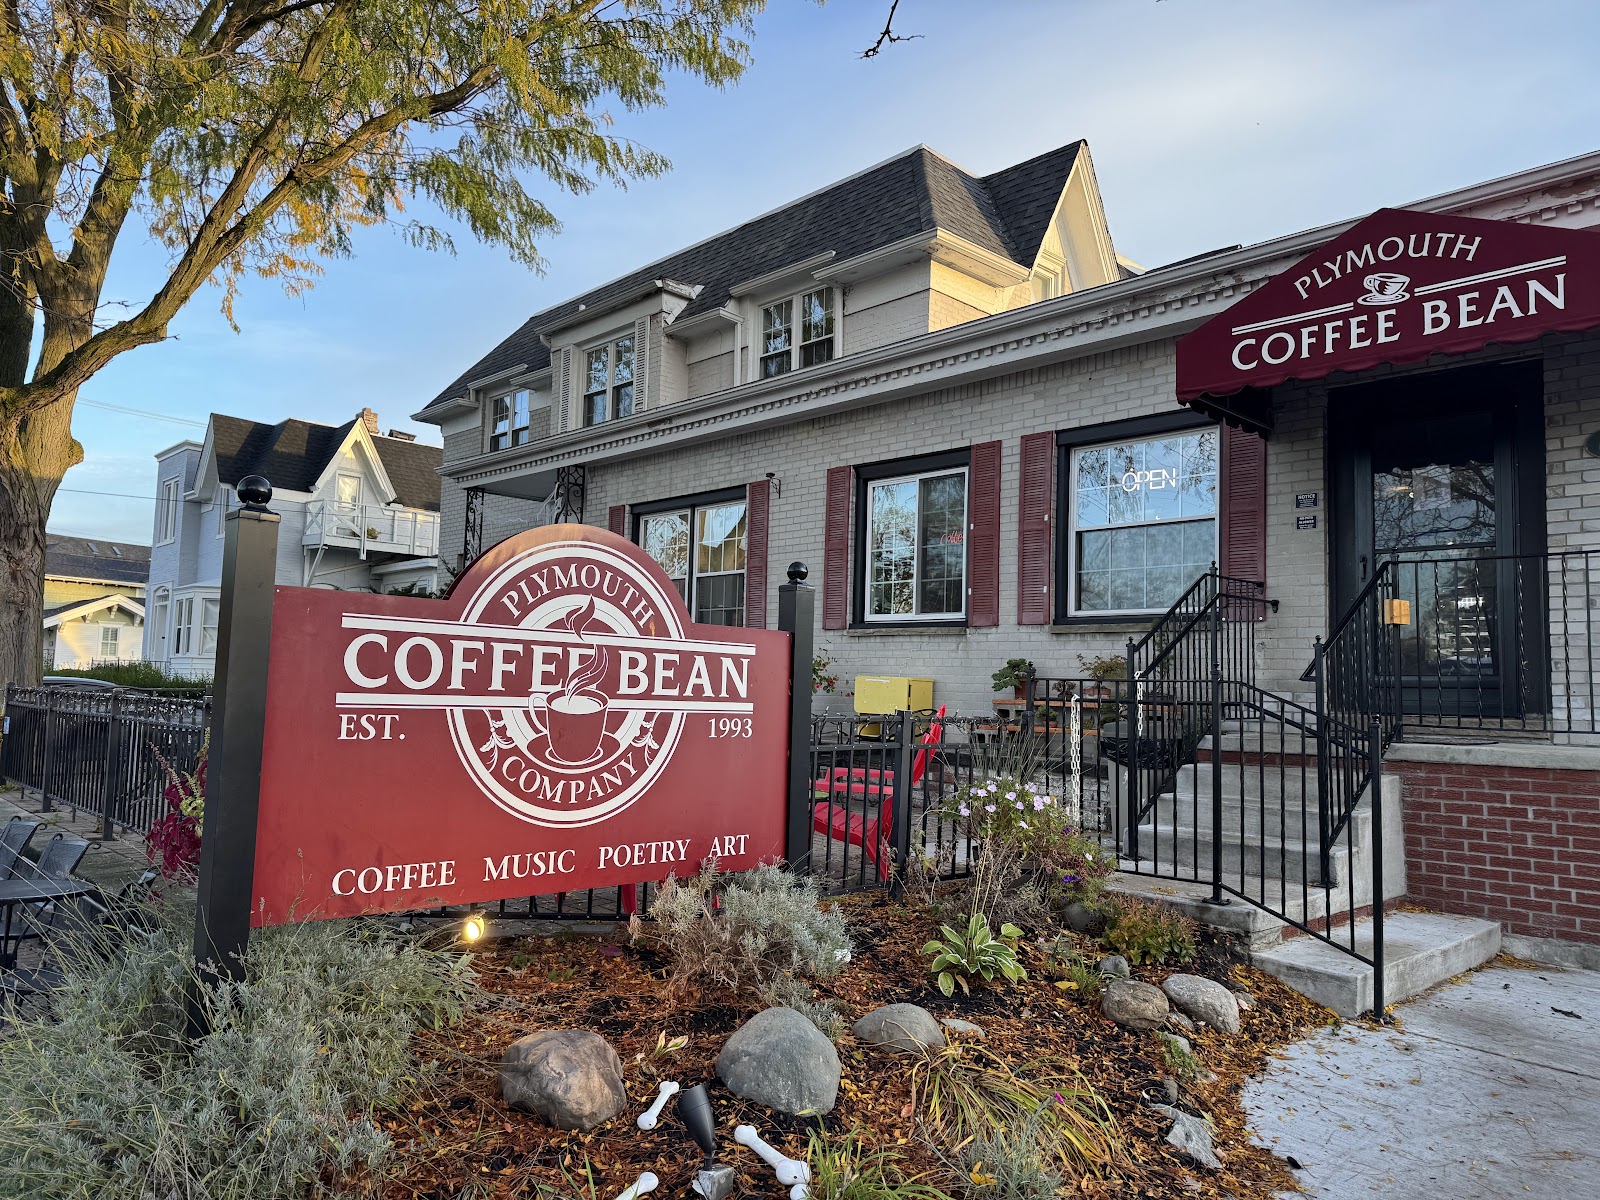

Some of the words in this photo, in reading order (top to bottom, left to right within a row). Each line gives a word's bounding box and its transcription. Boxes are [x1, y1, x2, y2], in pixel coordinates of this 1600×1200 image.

[1293, 232, 1482, 300] PLYMOUTH
[1231, 308, 1401, 371] COFFEE
[1422, 273, 1566, 336] BEAN
[1122, 467, 1176, 492] OPEN
[500, 563, 655, 629] PLYMOUTH
[616, 649, 751, 699] BEAN
[336, 713, 406, 741] EST.
[708, 717, 753, 739] 1993
[501, 751, 638, 804] COMPANY
[331, 860, 457, 896] COFFEE
[482, 849, 576, 882] MUSIC
[597, 838, 691, 870] POETRY
[707, 833, 750, 860] ART
